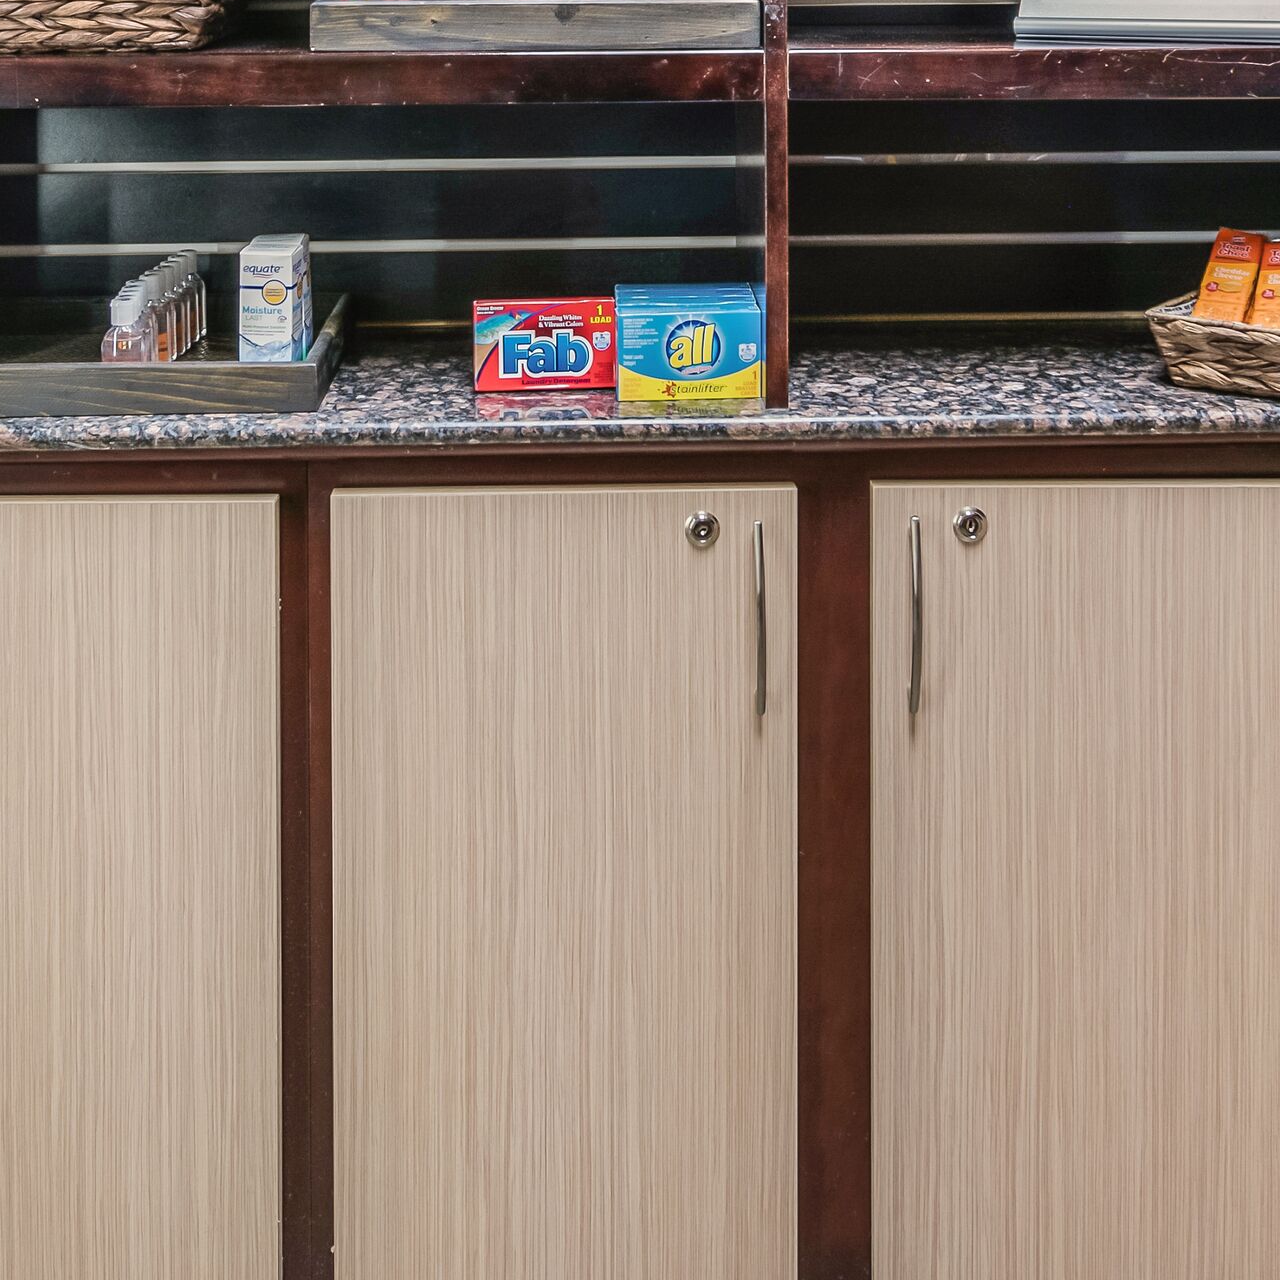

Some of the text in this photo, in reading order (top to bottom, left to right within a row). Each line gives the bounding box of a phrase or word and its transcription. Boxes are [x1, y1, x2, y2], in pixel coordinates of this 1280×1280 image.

[243, 264, 281, 275] equate
[1214, 266, 1251, 277] Cheddar
[1213, 272, 1244, 281] Cheese
[242, 306, 283, 315] Moisture
[597, 304, 603, 315] 1
[590, 316, 612, 324] LOAD
[669, 322, 717, 369] all
[502, 331, 591, 376] Fab
[670, 383, 725, 394] stainlifter
